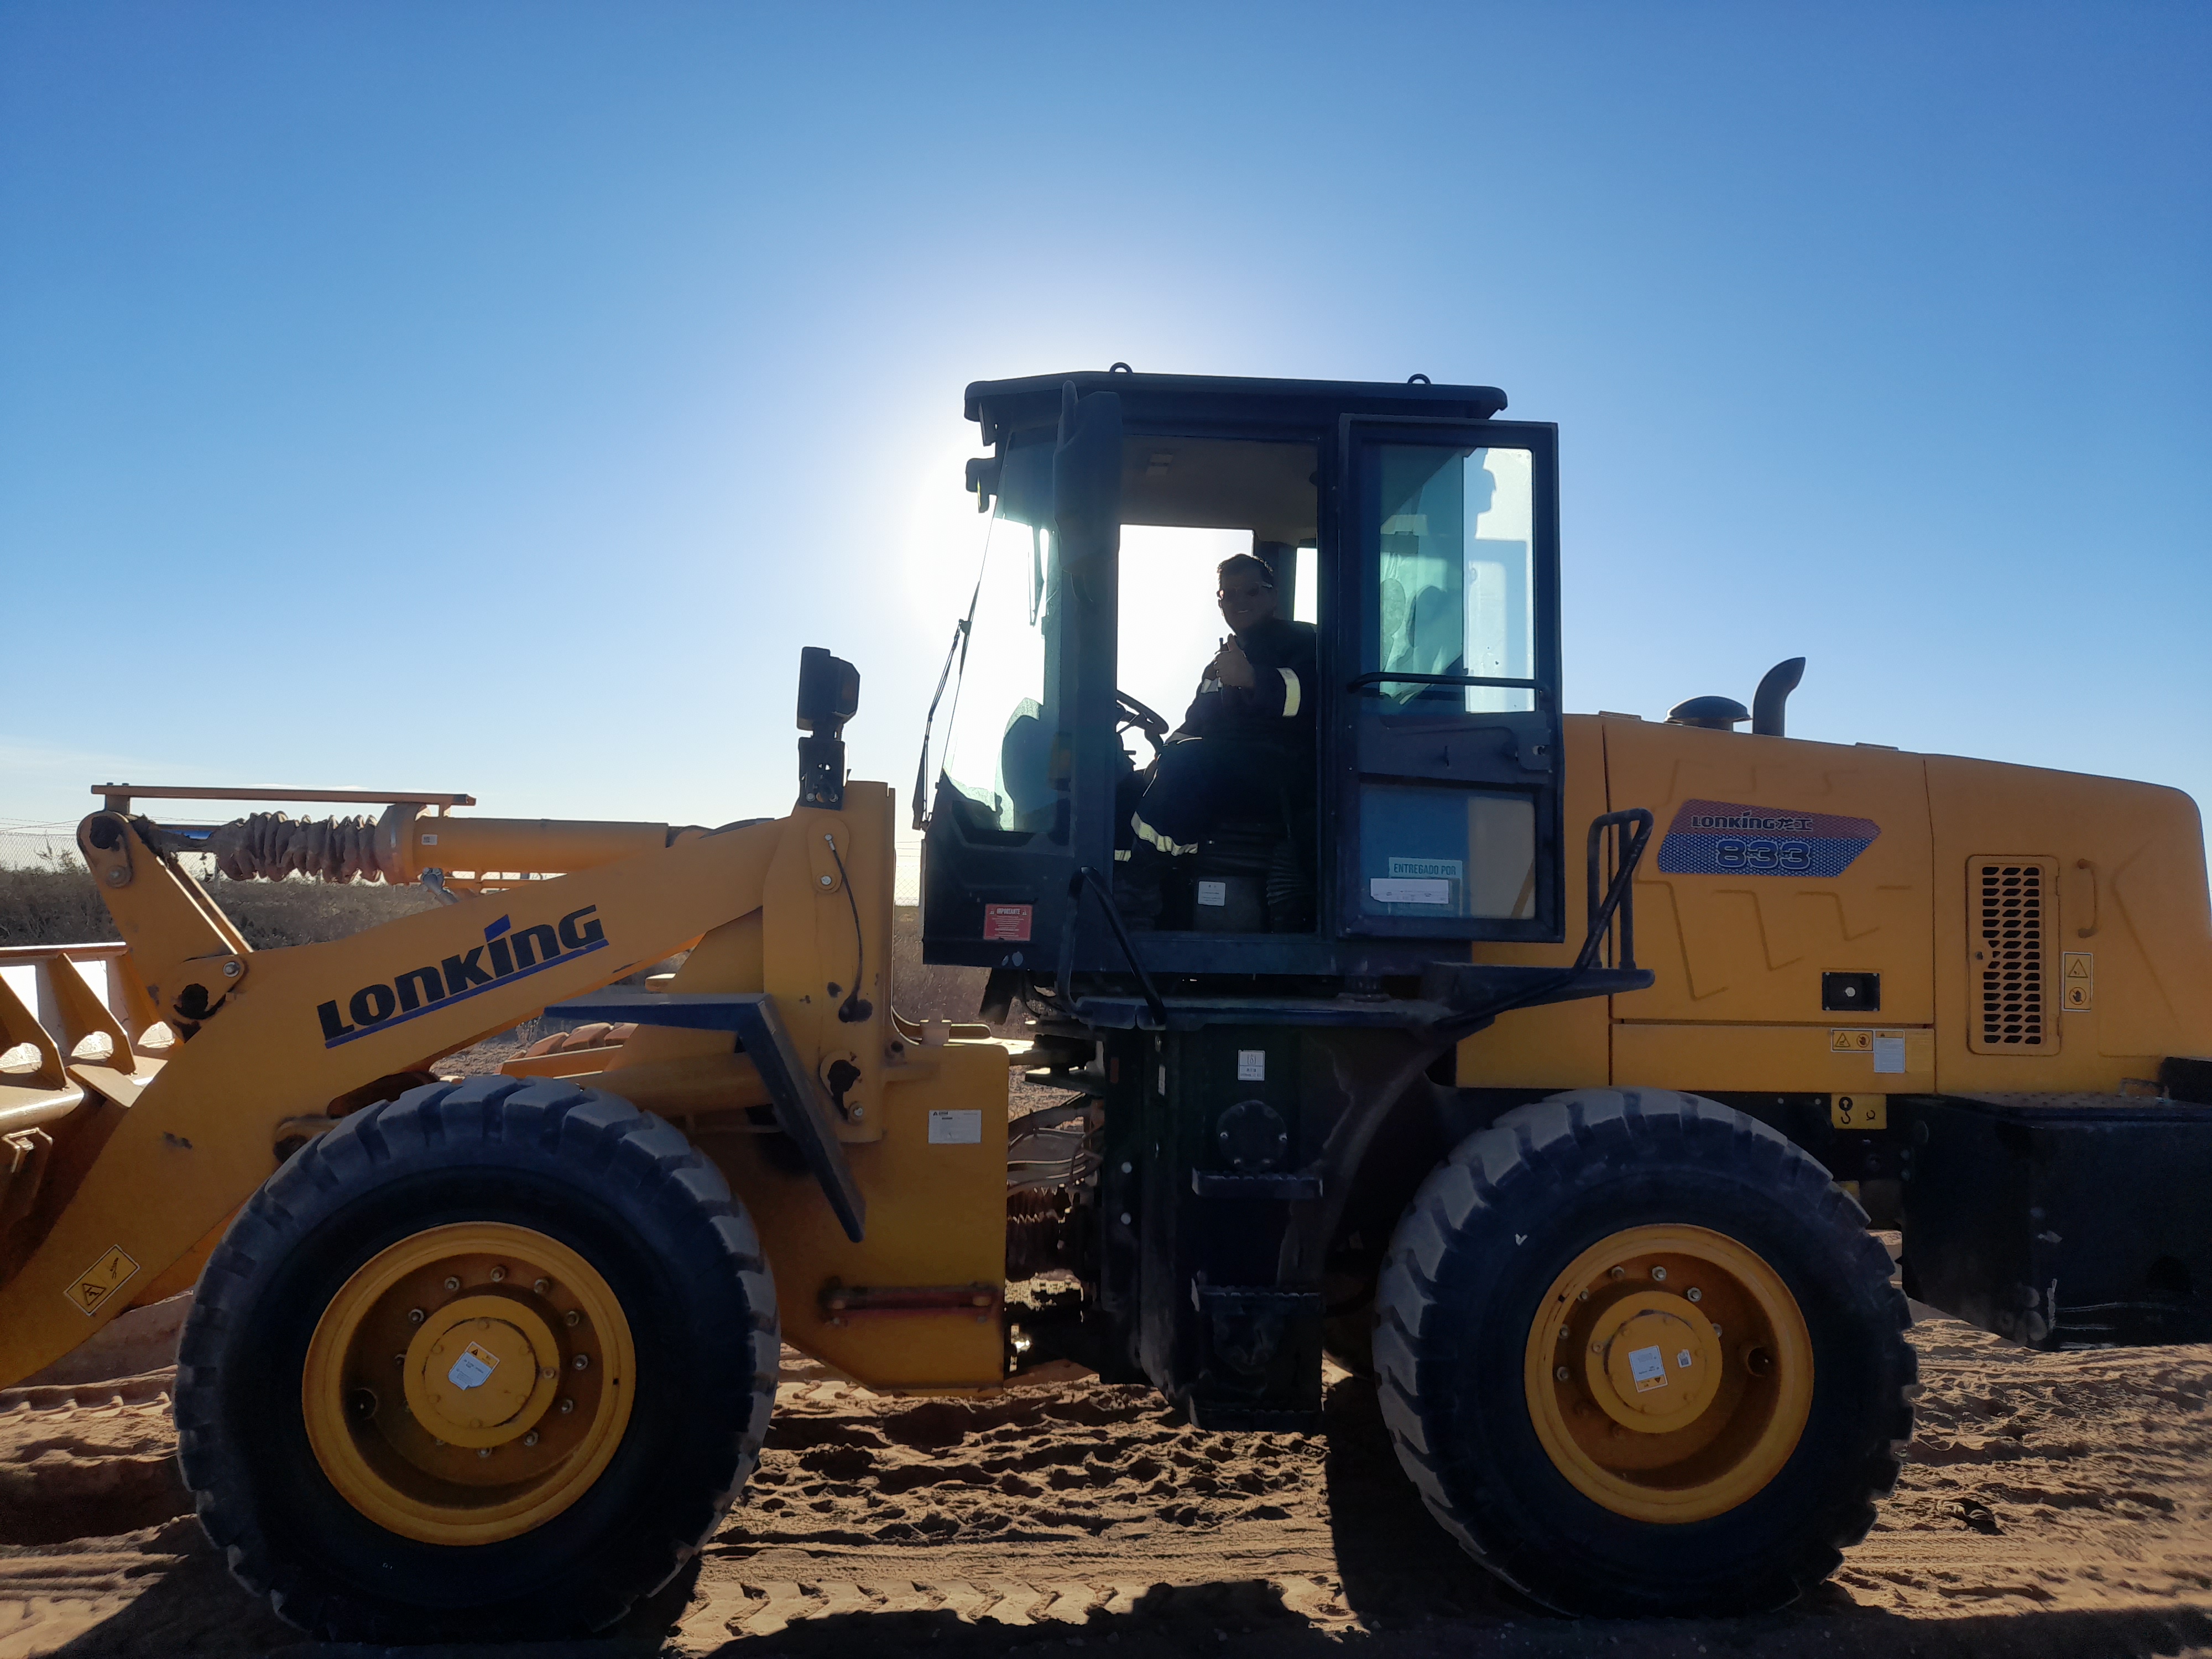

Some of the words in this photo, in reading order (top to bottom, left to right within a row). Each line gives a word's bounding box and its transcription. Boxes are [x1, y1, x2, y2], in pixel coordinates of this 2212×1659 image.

[1717, 839, 1812, 870] 833
[1394, 863, 1439, 875] ENTREGADO
[1441, 865, 1456, 875] POR
